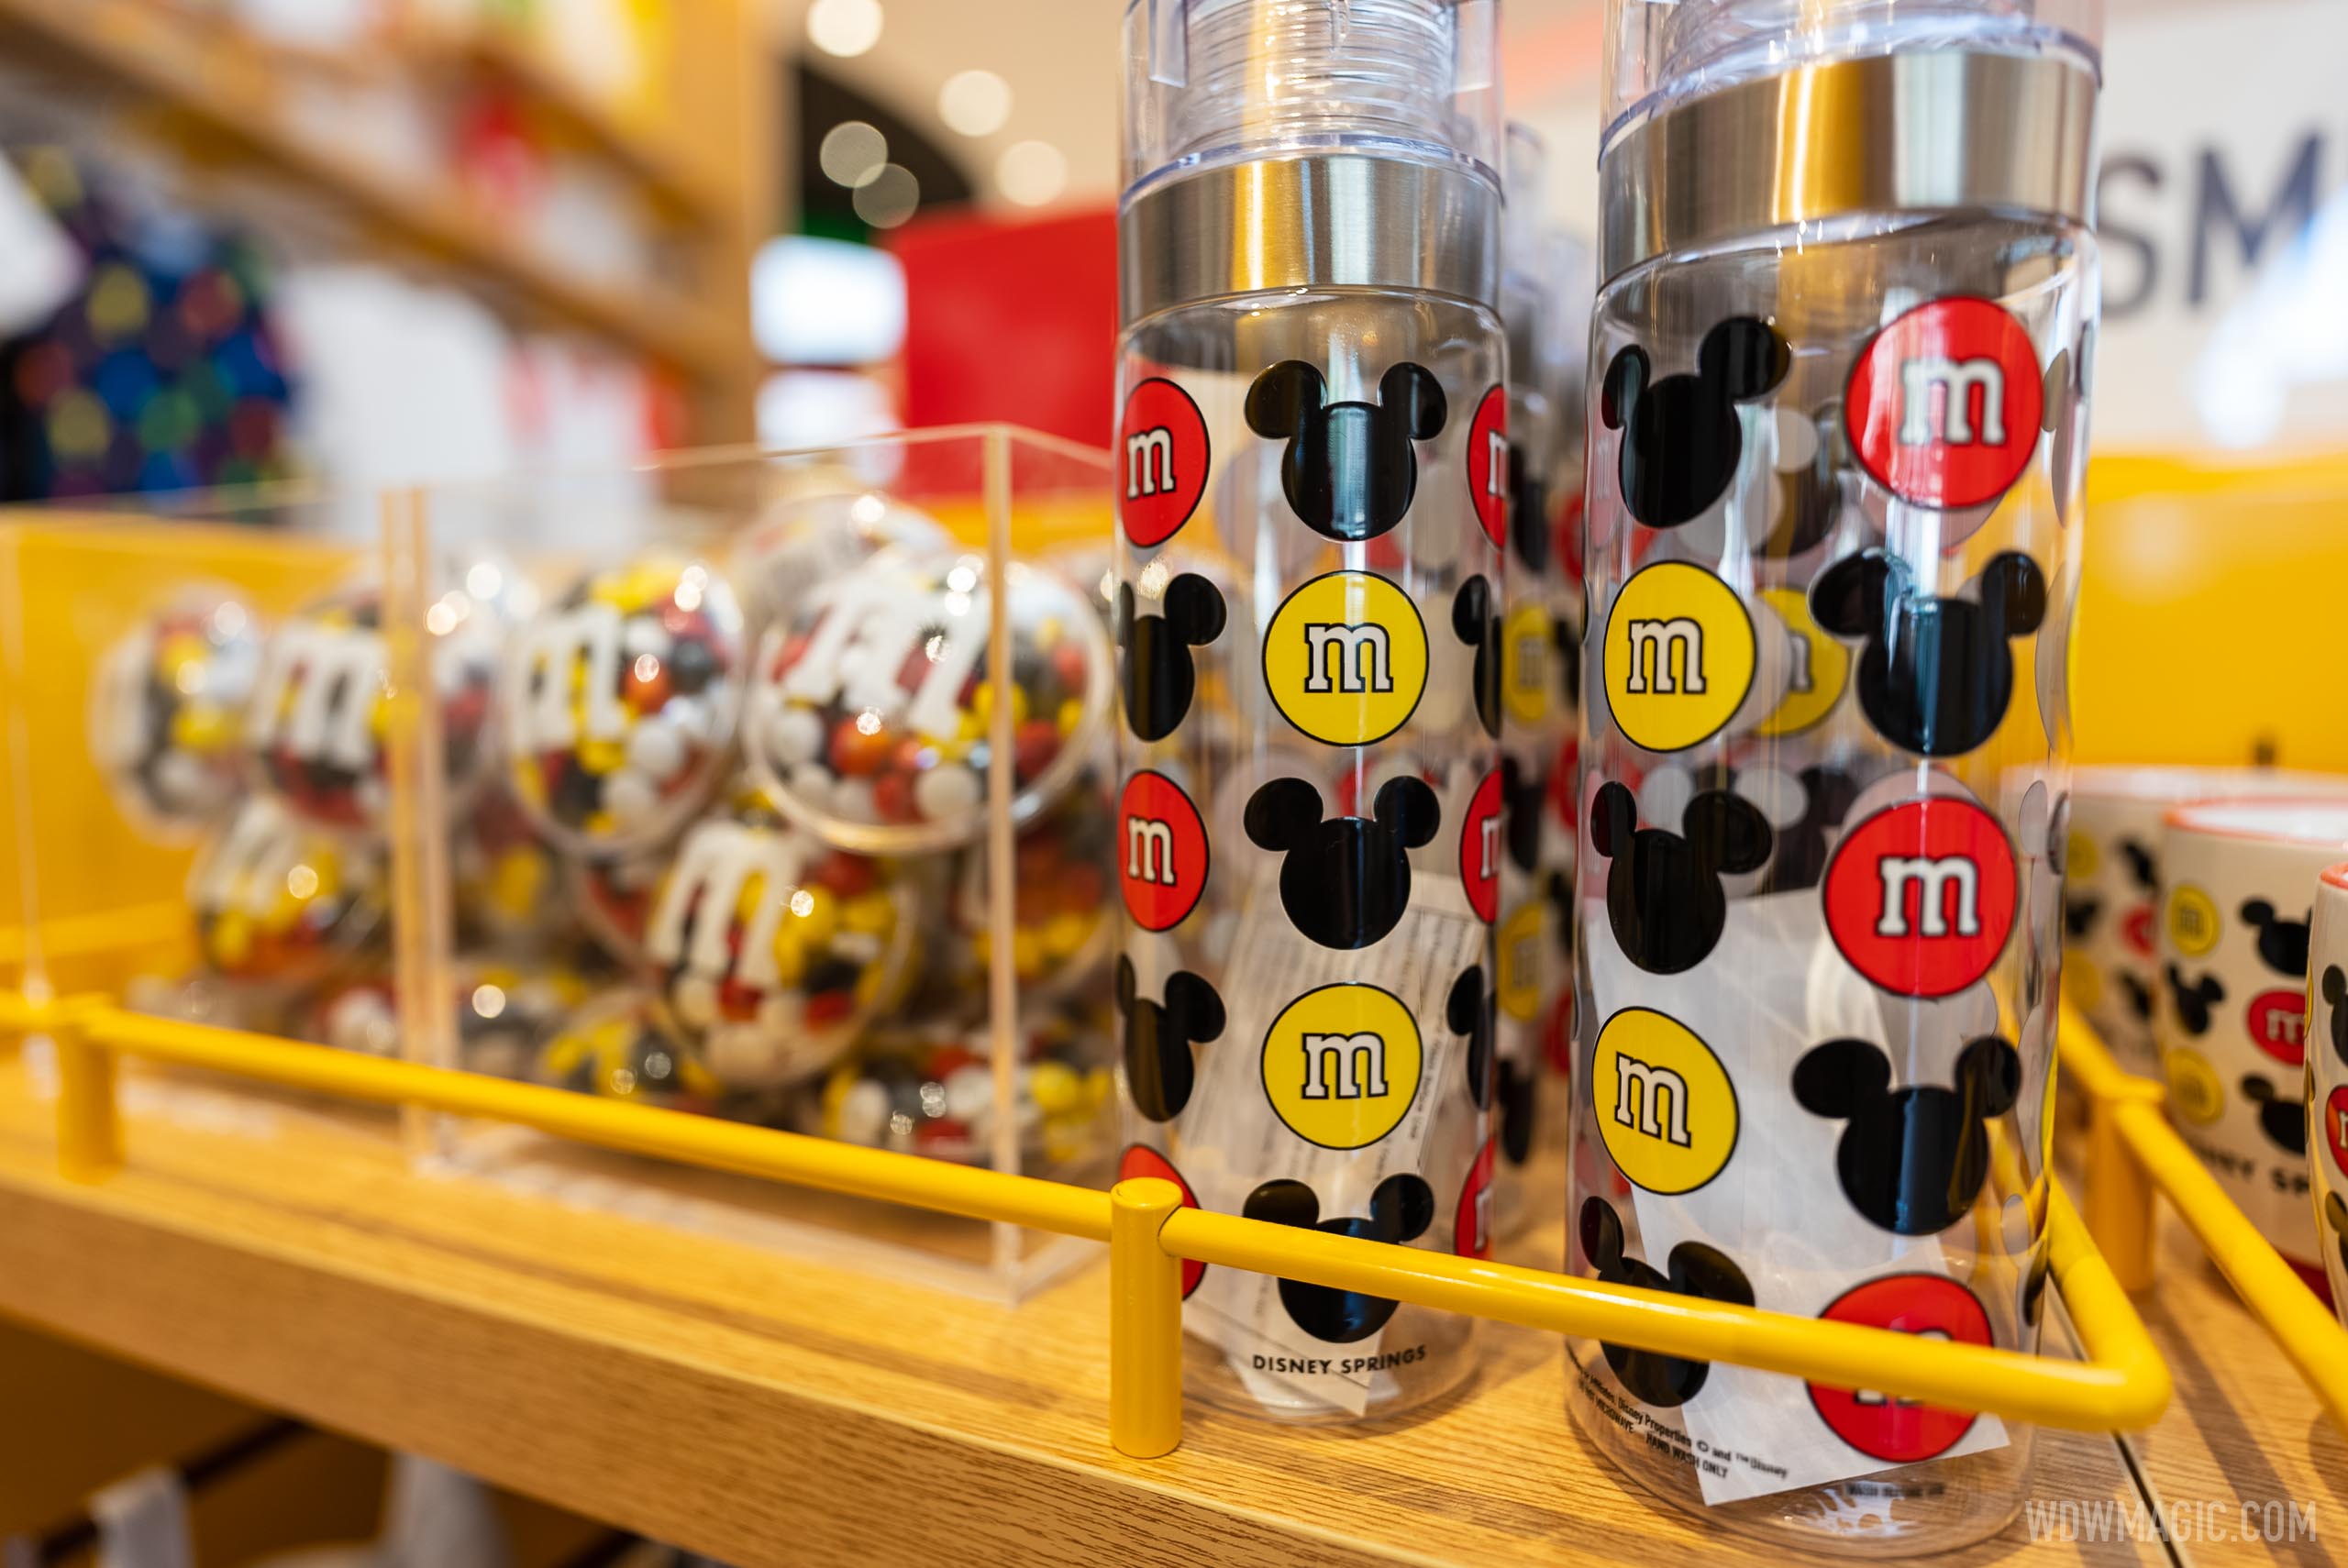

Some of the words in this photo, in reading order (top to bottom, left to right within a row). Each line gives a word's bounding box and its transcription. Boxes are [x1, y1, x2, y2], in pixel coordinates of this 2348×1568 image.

[1900, 357, 2006, 446] m
[1126, 425, 1176, 501] m
[1304, 622, 1394, 693] m
[1626, 617, 1707, 695] m
[1127, 815, 1177, 887] m
[1877, 855, 1981, 936] m
[1301, 1031, 1389, 1100] m
[1614, 1051, 1691, 1149] m
[1252, 1353, 1332, 1375] DISNEY
[1341, 1343, 1427, 1375] SPRINGS
[1702, 1461, 1728, 1479] ONLY
